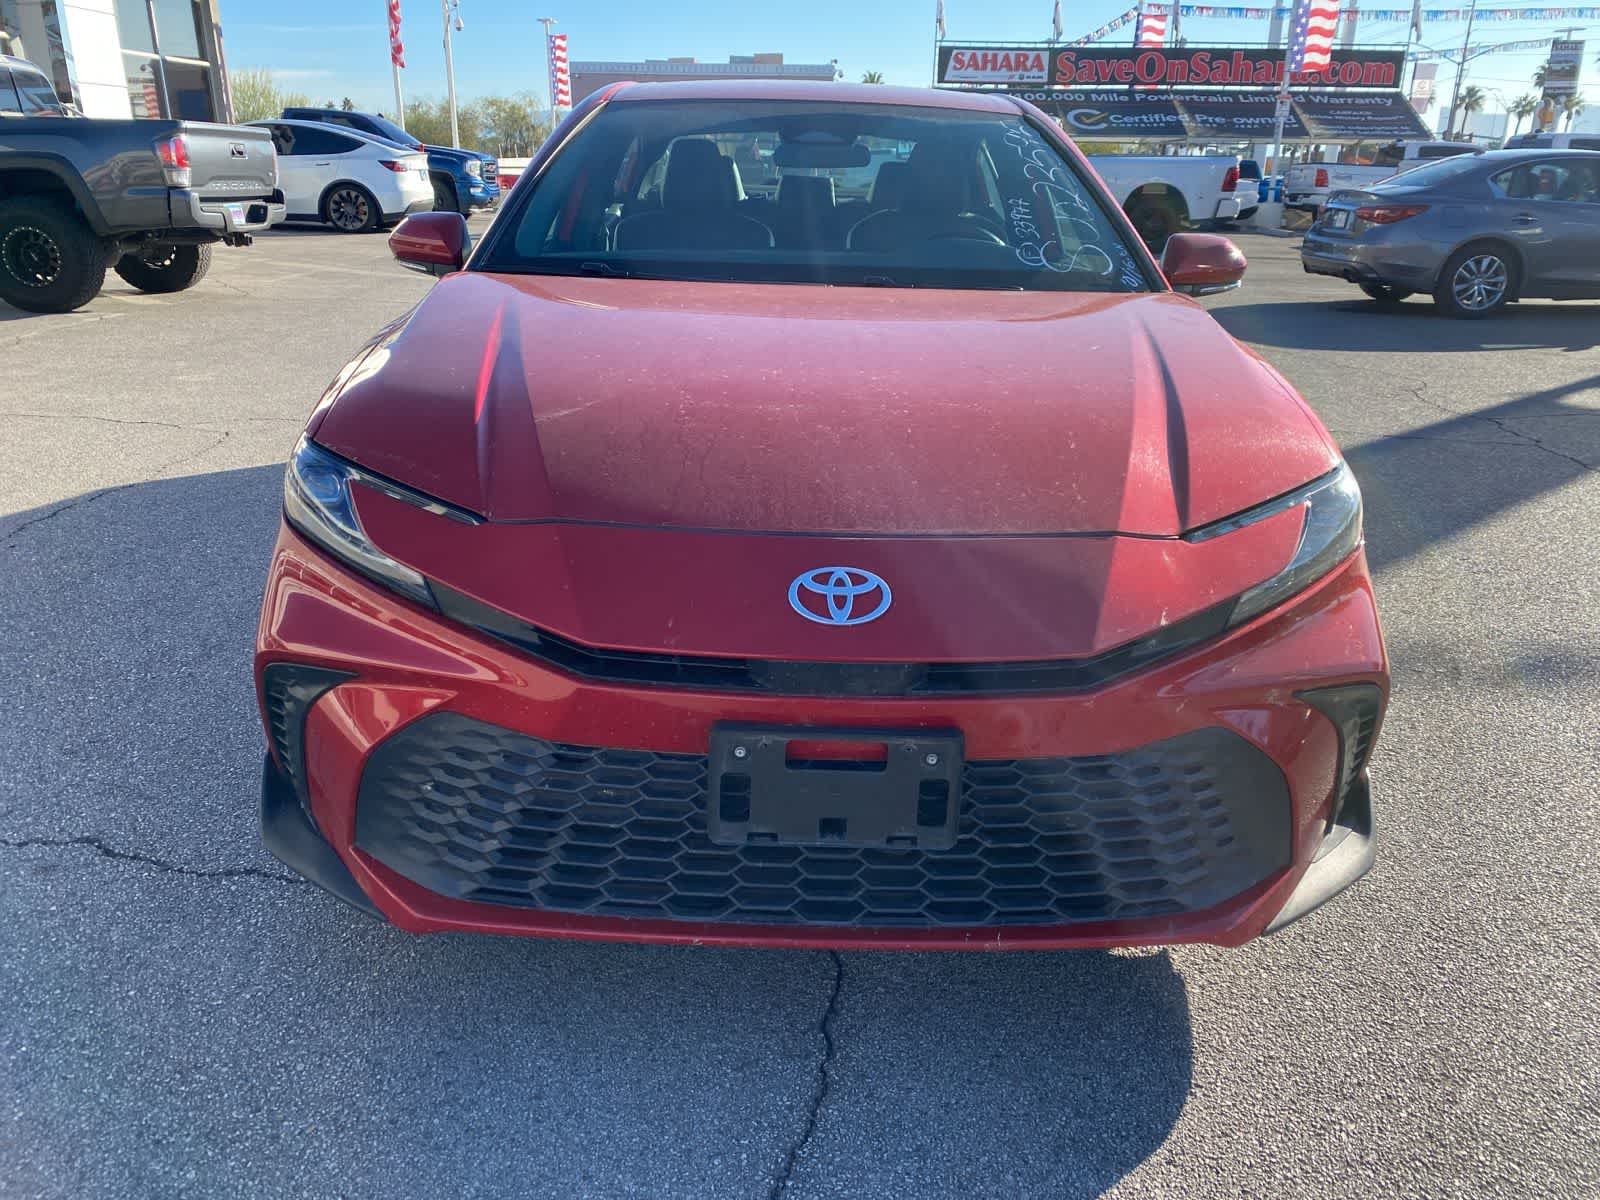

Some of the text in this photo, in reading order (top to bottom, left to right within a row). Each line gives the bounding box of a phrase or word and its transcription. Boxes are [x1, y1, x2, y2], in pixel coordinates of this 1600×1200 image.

[952, 51, 1045, 72] SAHARA
[1090, 93, 1129, 102] Mile
[1134, 93, 1233, 103] Powertrain
[1238, 94, 1306, 103] Limid
[1309, 94, 1393, 106] Warranty
[1109, 113, 1189, 123] Certified
